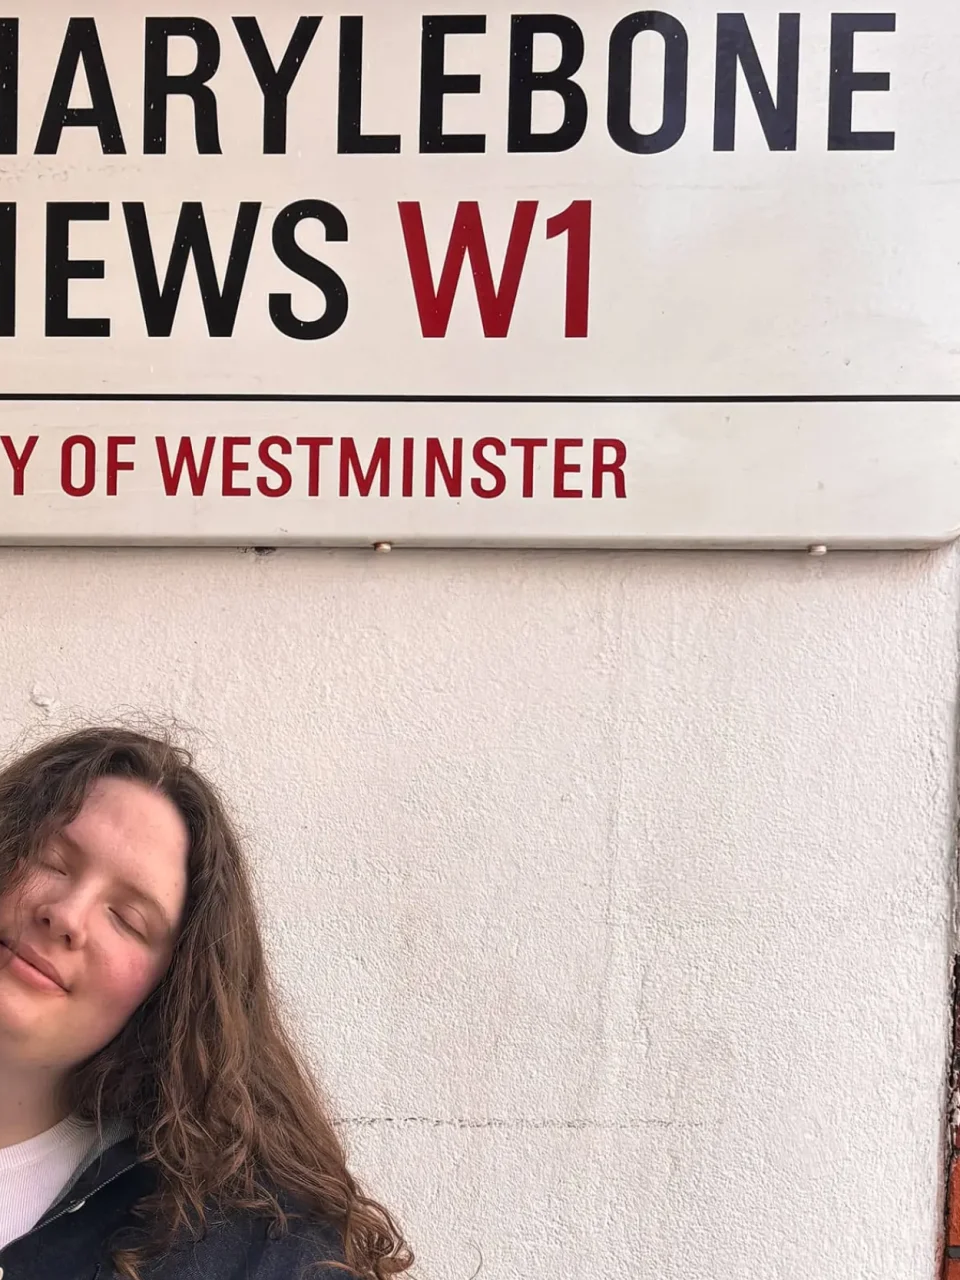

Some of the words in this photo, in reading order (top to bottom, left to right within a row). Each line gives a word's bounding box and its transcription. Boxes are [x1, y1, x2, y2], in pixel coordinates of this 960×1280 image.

[397, 199, 592, 339] W1
[60, 434, 137, 497] OF
[155, 435, 628, 499] WESTMINSTER
